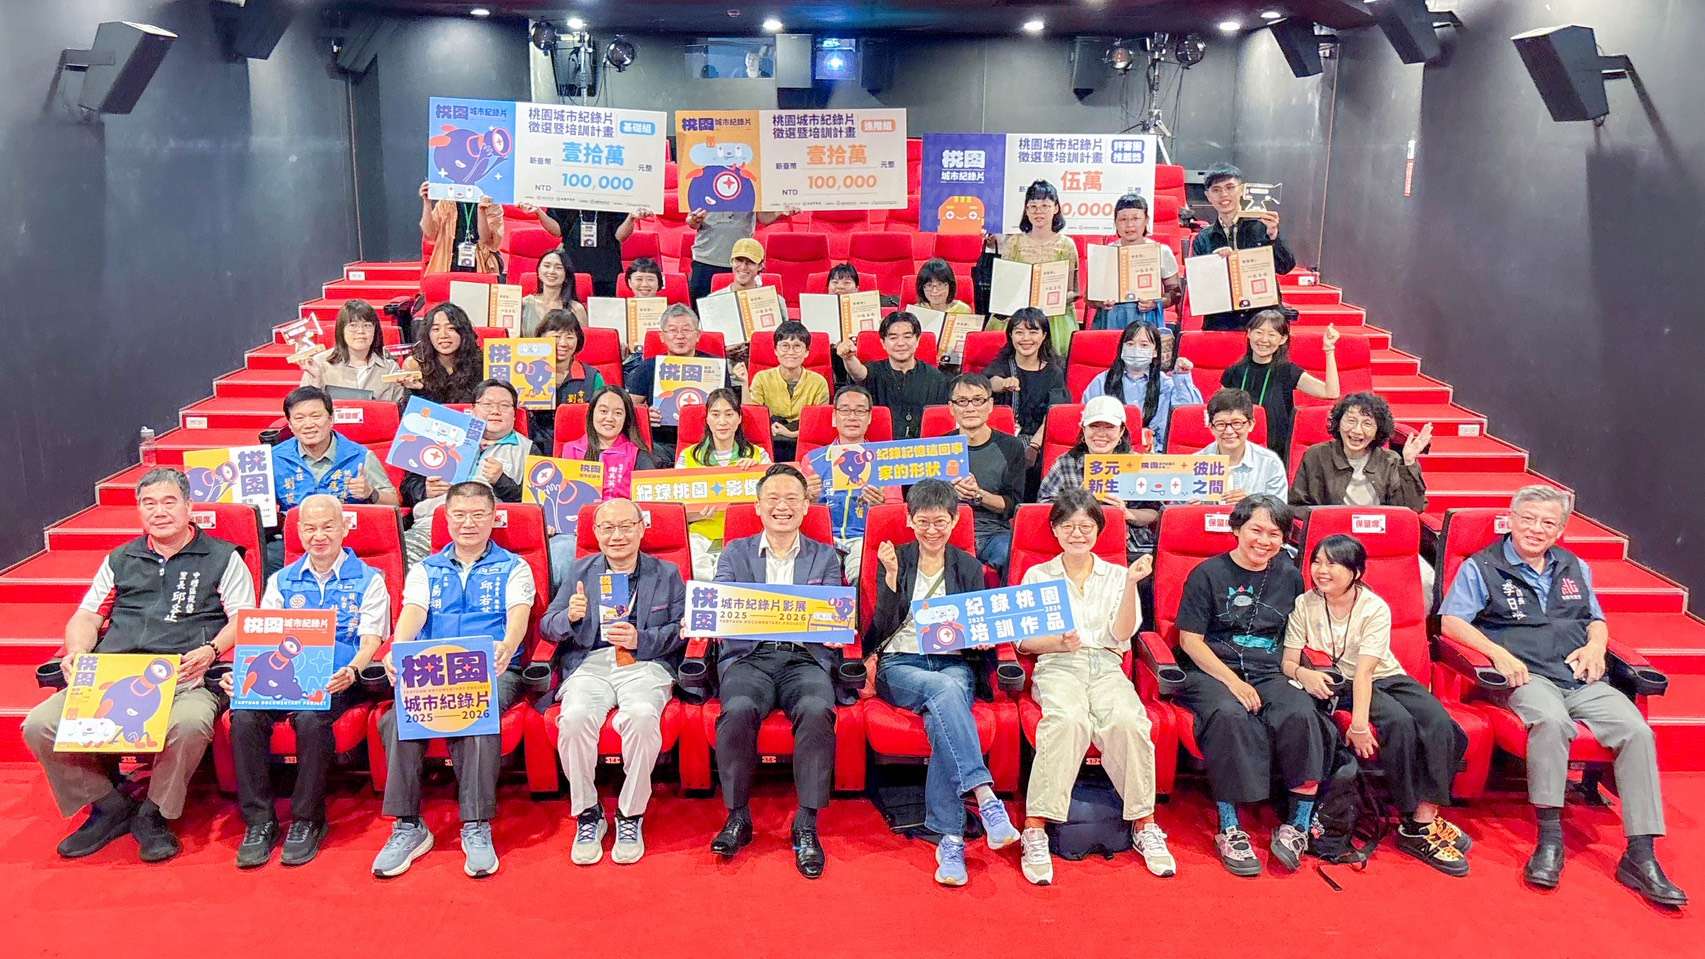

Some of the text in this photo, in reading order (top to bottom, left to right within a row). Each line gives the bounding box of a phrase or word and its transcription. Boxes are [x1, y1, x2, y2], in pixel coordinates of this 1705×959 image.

[435, 104, 508, 121] 桃園 城市紀錄片
[528, 107, 614, 125] 桃園城市紀錄片
[772, 114, 855, 127] 桃園城市紀錄片
[528, 120, 615, 139] 徵選暨培訓計畫
[682, 117, 752, 132] 桃園 城市紀錄片
[772, 127, 856, 139] 徵選暨培訓計畫
[562, 141, 625, 166] 壹拾萬
[1018, 138, 1103, 151] 桃園城市紀錄片
[806, 144, 867, 166] 壹拾萬
[942, 150, 986, 169] 桃園
[1018, 151, 1104, 164] 徵選暨培訓計畫
[562, 173, 634, 191] 100,000
[807, 175, 878, 190] 100,000
[941, 170, 985, 183] 城市紀錄片
[1060, 170, 1104, 192] 伍萬
[535, 184, 552, 192] NTD
[659, 362, 704, 382] 桃園
[876, 442, 964, 461] 紀錄記憶這回事
[238, 450, 270, 497] 桃園
[580, 463, 601, 473] 桃園
[877, 460, 942, 482] 家的形狀
[1089, 460, 1120, 476] 多元
[1192, 461, 1225, 476] 彼此
[636, 480, 708, 500] 紀錄桃園
[1088, 479, 1120, 495] 新生
[1192, 479, 1225, 495] 之間
[691, 587, 718, 632] 桃園
[720, 597, 807, 612] 城市紀錄片影展
[965, 585, 1061, 617] 紀錄桃園
[719, 610, 807, 621] 2025 2026
[243, 616, 328, 634] 桃園 城市紀錄片
[969, 612, 1066, 643] 培訓作品
[74, 655, 98, 687] 桃園
[402, 650, 489, 689] 桃園
[404, 690, 490, 713] 城市紀錄片
[405, 709, 490, 723] 2025 2026
